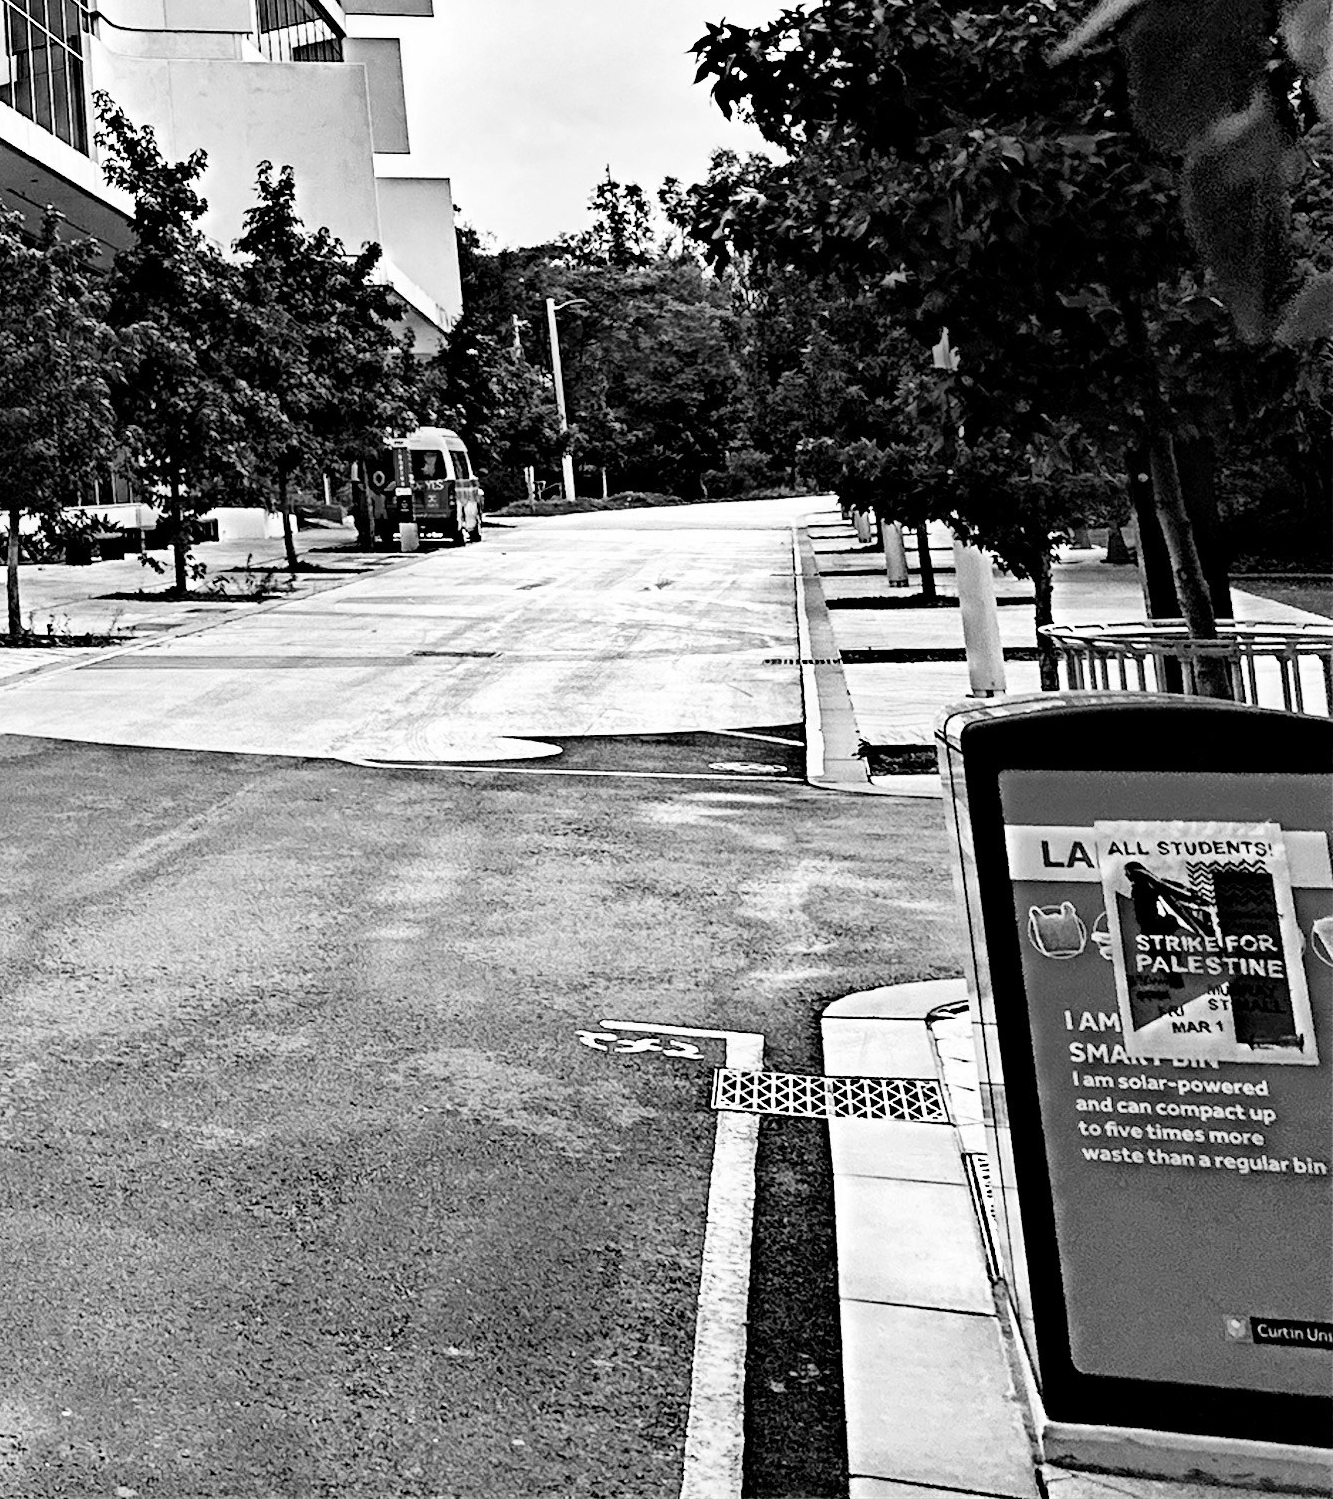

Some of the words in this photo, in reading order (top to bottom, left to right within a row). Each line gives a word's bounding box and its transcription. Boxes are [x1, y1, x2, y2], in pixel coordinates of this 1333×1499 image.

[1108, 841, 1149, 856] ALL
[1157, 840, 1274, 857] STUDENTS!
[1136, 934, 1220, 953] STRIKE
[1226, 934, 1278, 953] FOR
[1136, 953, 1285, 979] PALESTINE
[1209, 998, 1230, 1012] ST
[1064, 1010, 1074, 1031] I
[1079, 1012, 1121, 1033] AM
[1172, 1021, 1212, 1034] MAR
[1216, 1020, 1224, 1033] 1
[1072, 1071, 1079, 1087] I
[1082, 1075, 1114, 1088] am
[1117, 1073, 1269, 1097] solar-powered
[1075, 1097, 1113, 1113] and
[1116, 1100, 1152, 1115] can
[1156, 1102, 1246, 1122] compact
[1249, 1107, 1277, 1126] up
[1078, 1122, 1102, 1137] to
[1104, 1121, 1143, 1140] five
[1145, 1124, 1204, 1143] times
[1209, 1129, 1265, 1147] more
[1081, 1147, 1144, 1165] waste
[1147, 1148, 1195, 1168] than
[1199, 1154, 1211, 1169] a
[1215, 1154, 1290, 1175] regular
[1293, 1156, 1327, 1176] bin
[1257, 1323, 1304, 1340] Curtin
